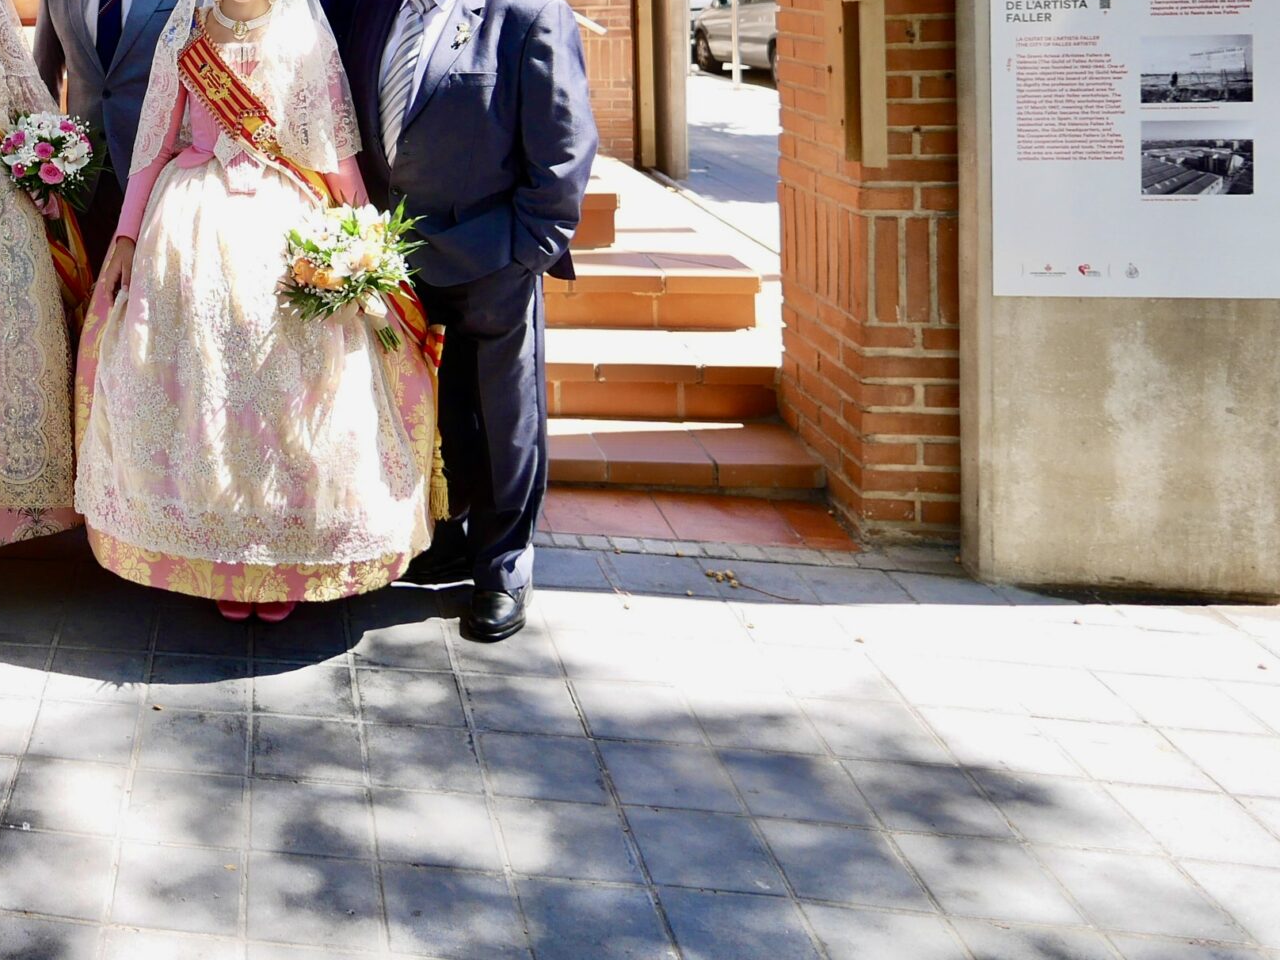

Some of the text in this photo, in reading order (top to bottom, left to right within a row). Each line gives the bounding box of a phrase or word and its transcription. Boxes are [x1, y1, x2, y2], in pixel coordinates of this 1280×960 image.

[1006, 0, 1088, 10] DE L'ARTISTA
[1006, 13, 1052, 22] FALLER
